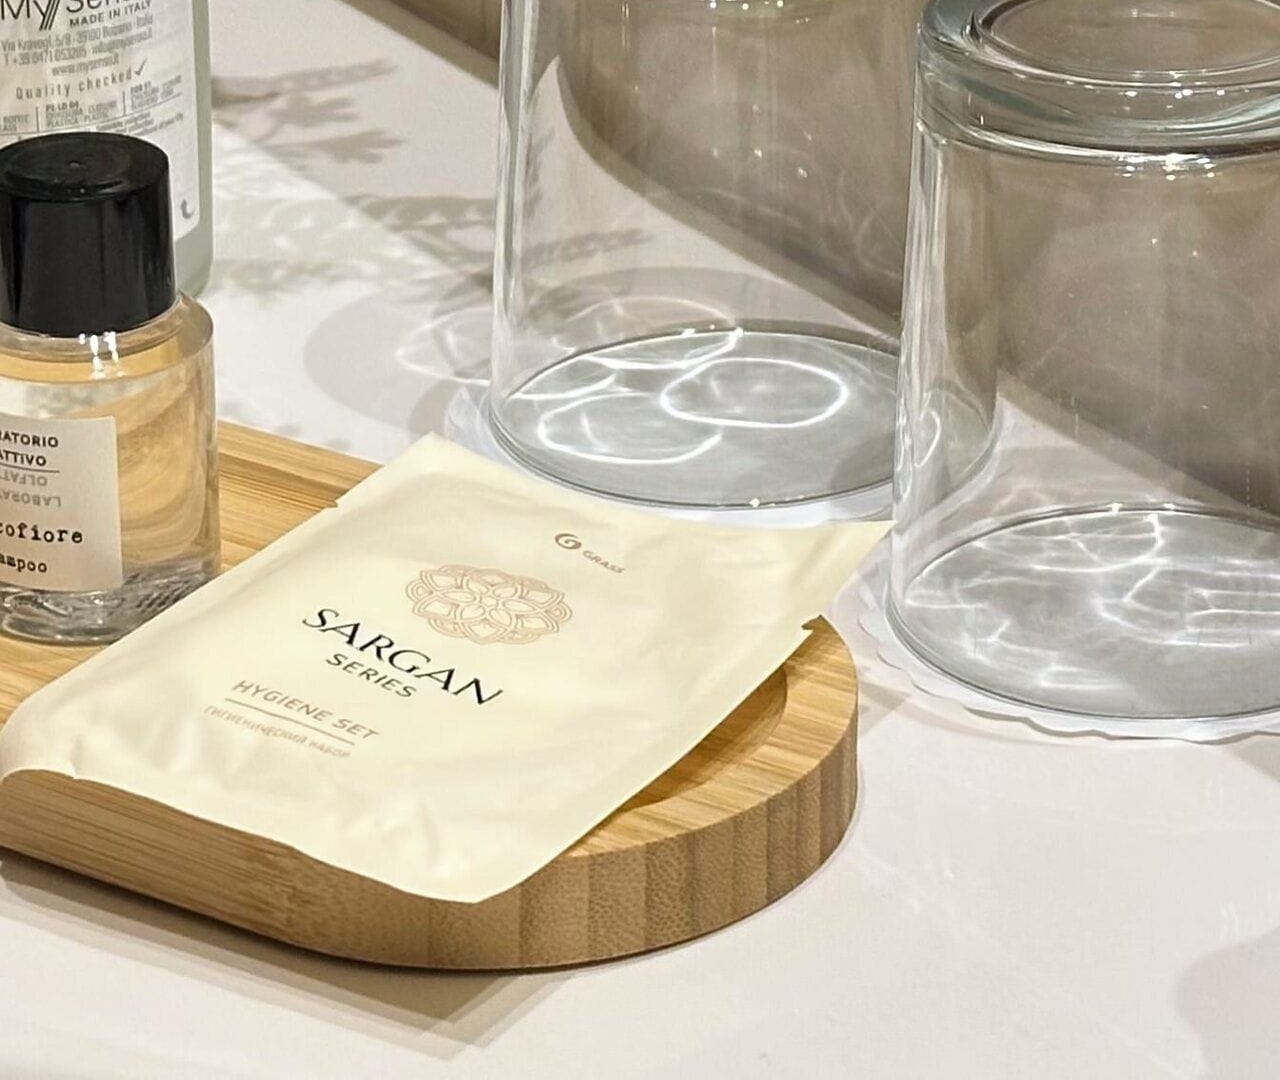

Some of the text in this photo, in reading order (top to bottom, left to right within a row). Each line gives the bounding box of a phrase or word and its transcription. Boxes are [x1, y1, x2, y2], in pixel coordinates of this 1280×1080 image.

[69, 12, 104, 28] MADE
[109, 7, 121, 19] IN
[15, 67, 132, 99] Quality checked
[582, 550, 625, 574] GRASS
[302, 608, 503, 705] SARGAN
[325, 653, 417, 698] SERIES
[231, 680, 380, 739] HYGIENE SET
